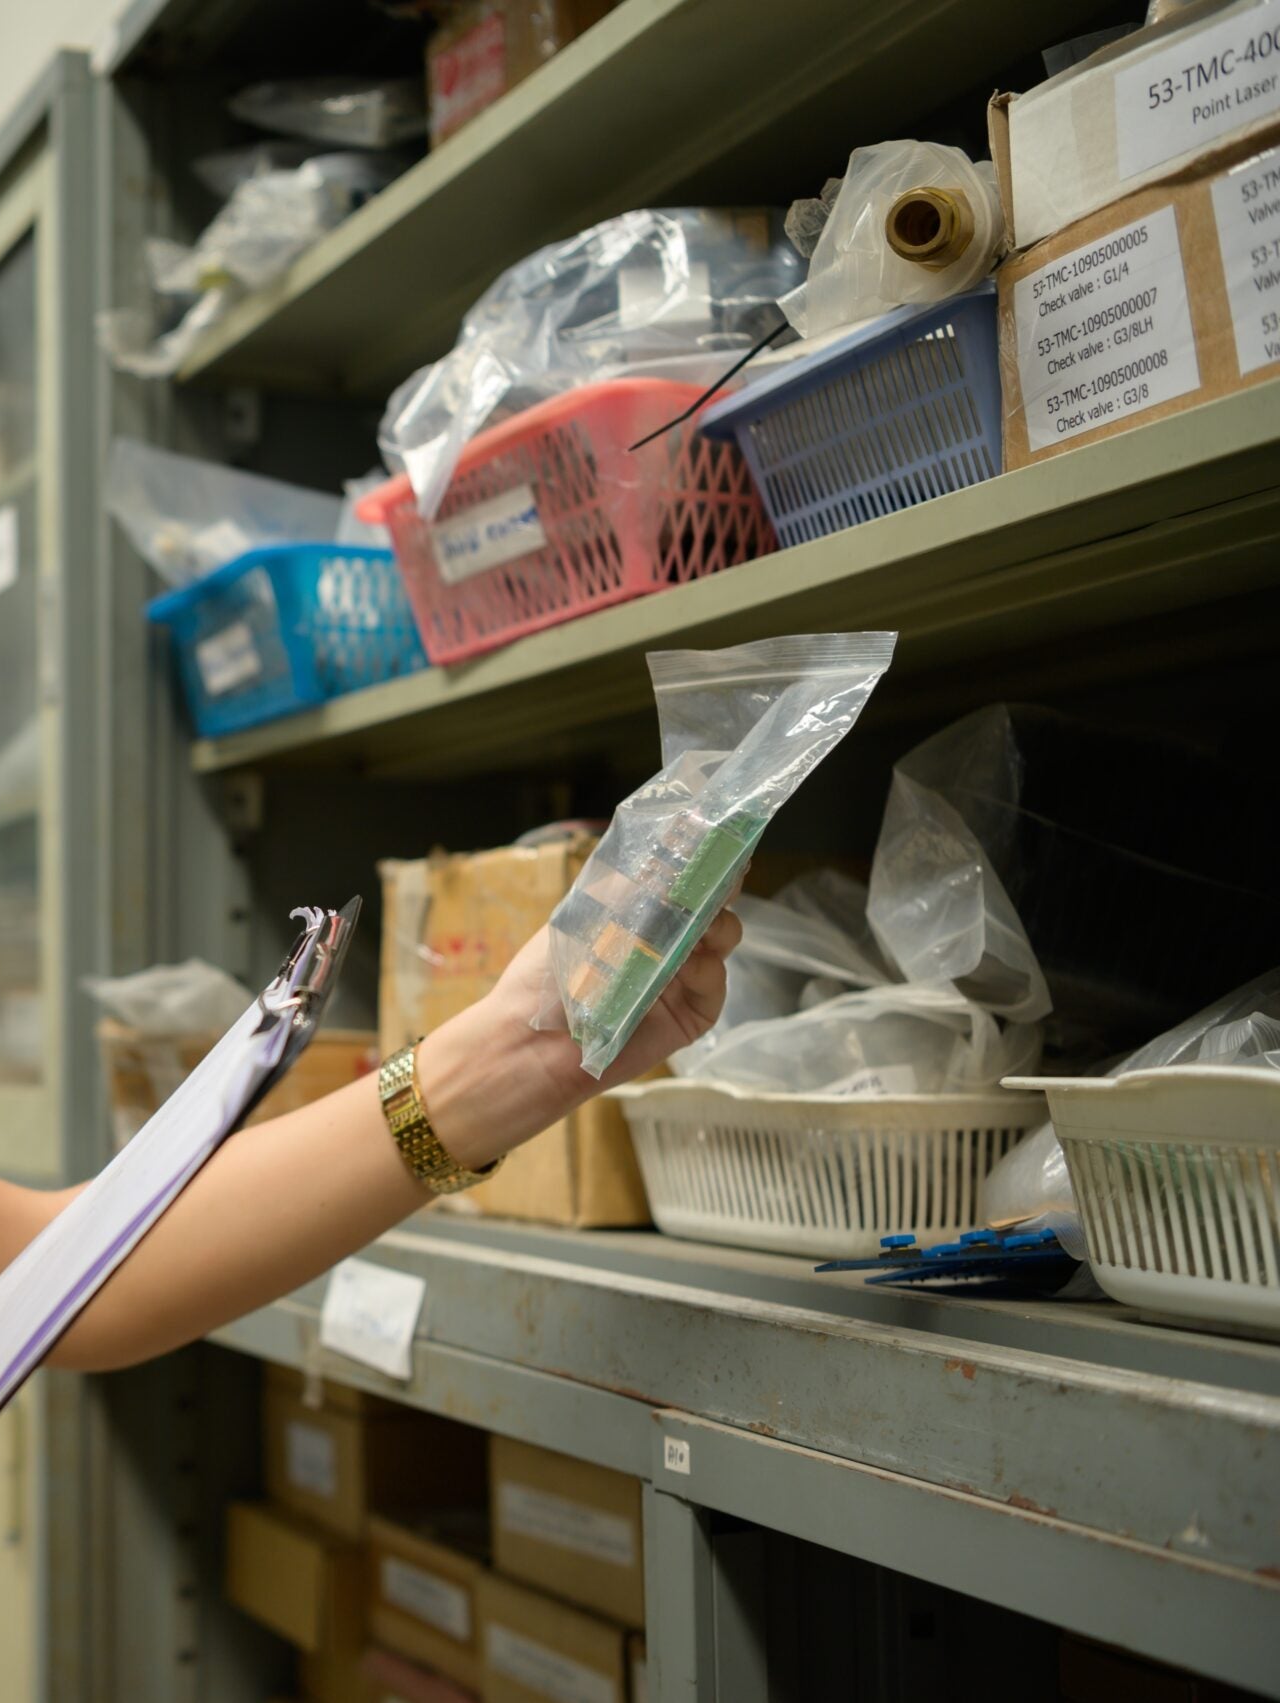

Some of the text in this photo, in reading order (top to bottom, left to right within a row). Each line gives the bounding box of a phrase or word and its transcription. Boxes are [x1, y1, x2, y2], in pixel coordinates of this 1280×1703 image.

[1192, 75, 1278, 124] Point Laser
[1032, 225, 1149, 300] 53-TMC-10905000005
[1039, 293, 1068, 317] Check
[1068, 281, 1094, 303] valve
[1103, 261, 1130, 285] G1/4
[1037, 286, 1158, 357] 53-TMC-10905000007
[1047, 351, 1077, 375] Check
[1077, 341, 1105, 362] valve
[1113, 315, 1154, 345] G3/8LH
[1046, 349, 1169, 415] 53-TMC-10905000008
[1056, 410, 1086, 433] Check
[1087, 399, 1114, 420] valve
[1123, 383, 1149, 405] G3/8
